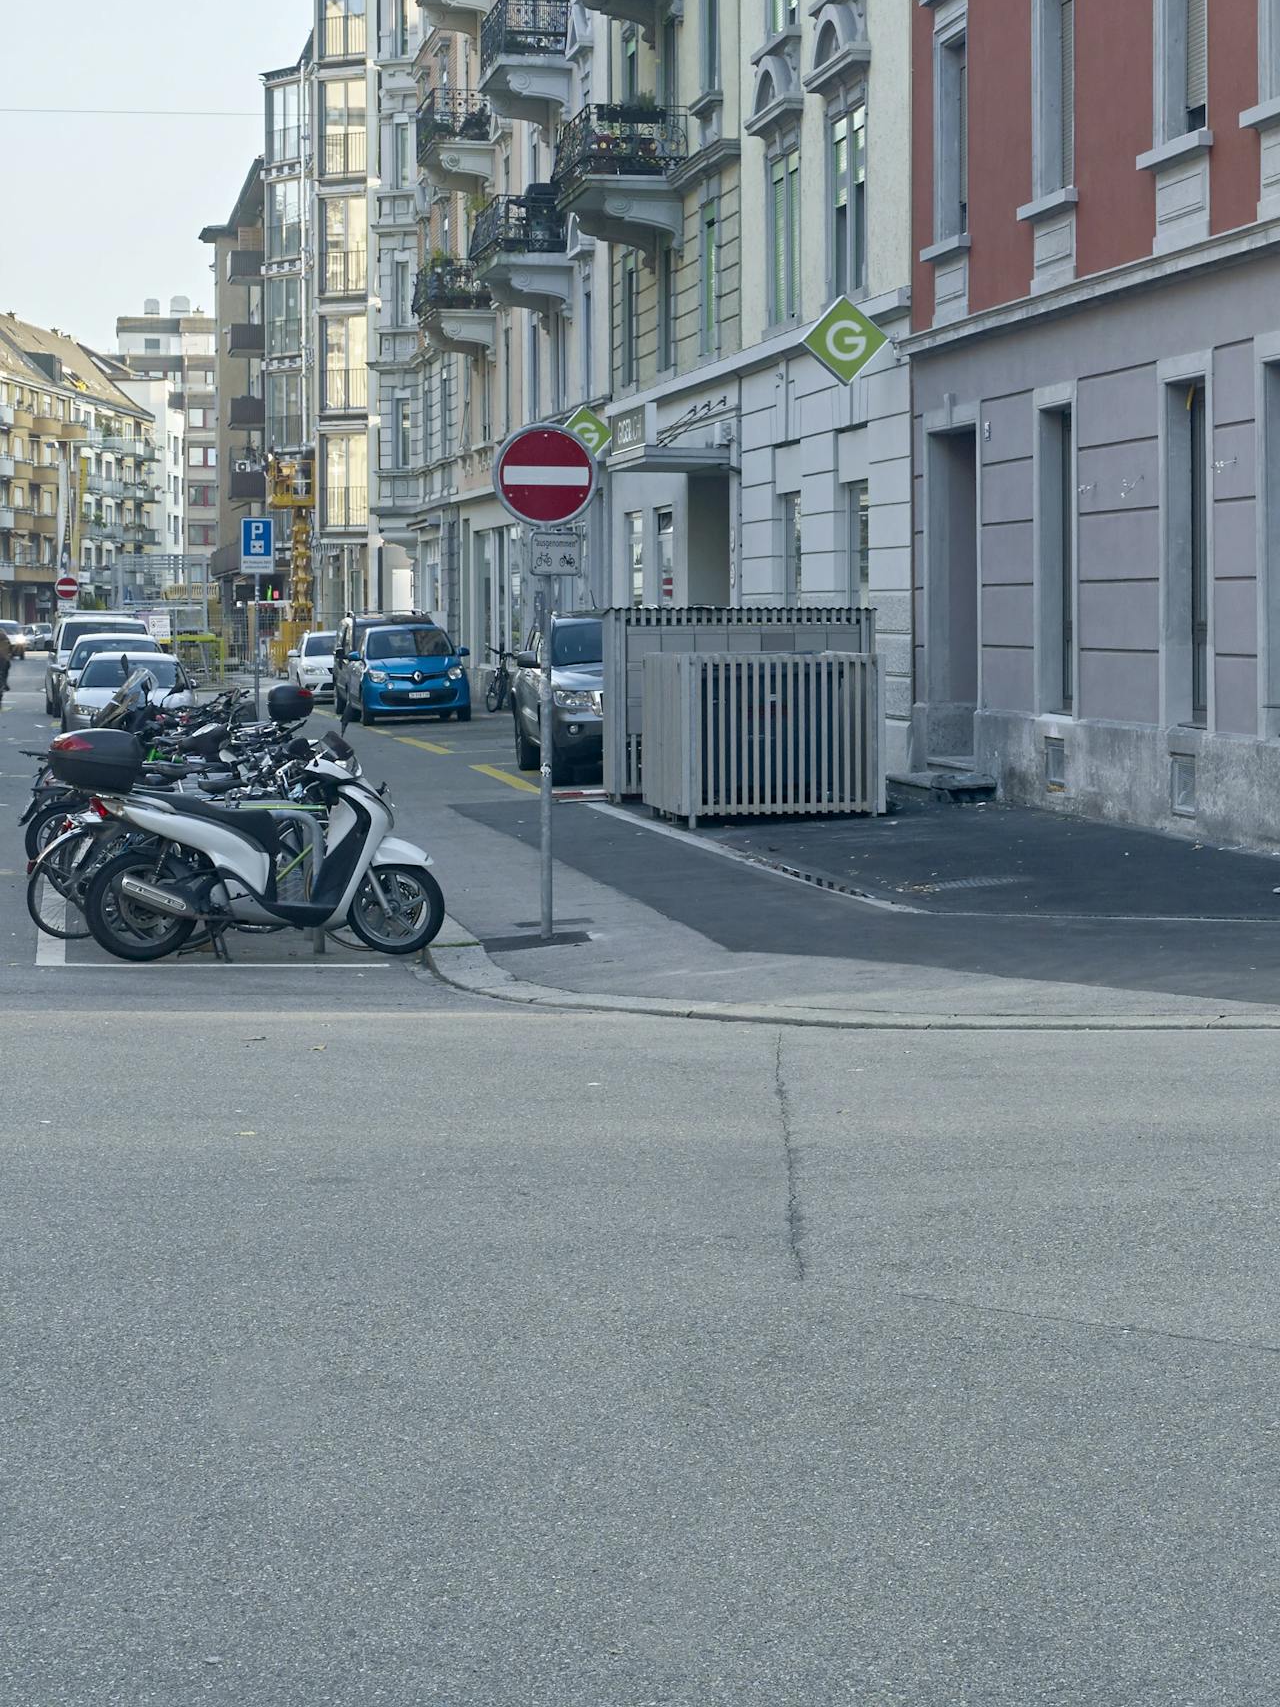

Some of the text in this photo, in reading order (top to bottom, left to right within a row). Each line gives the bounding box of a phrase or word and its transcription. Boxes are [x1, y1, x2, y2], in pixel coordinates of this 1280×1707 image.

[826, 319, 866, 362] G
[573, 422, 600, 448] G
[251, 522, 264, 540] P
